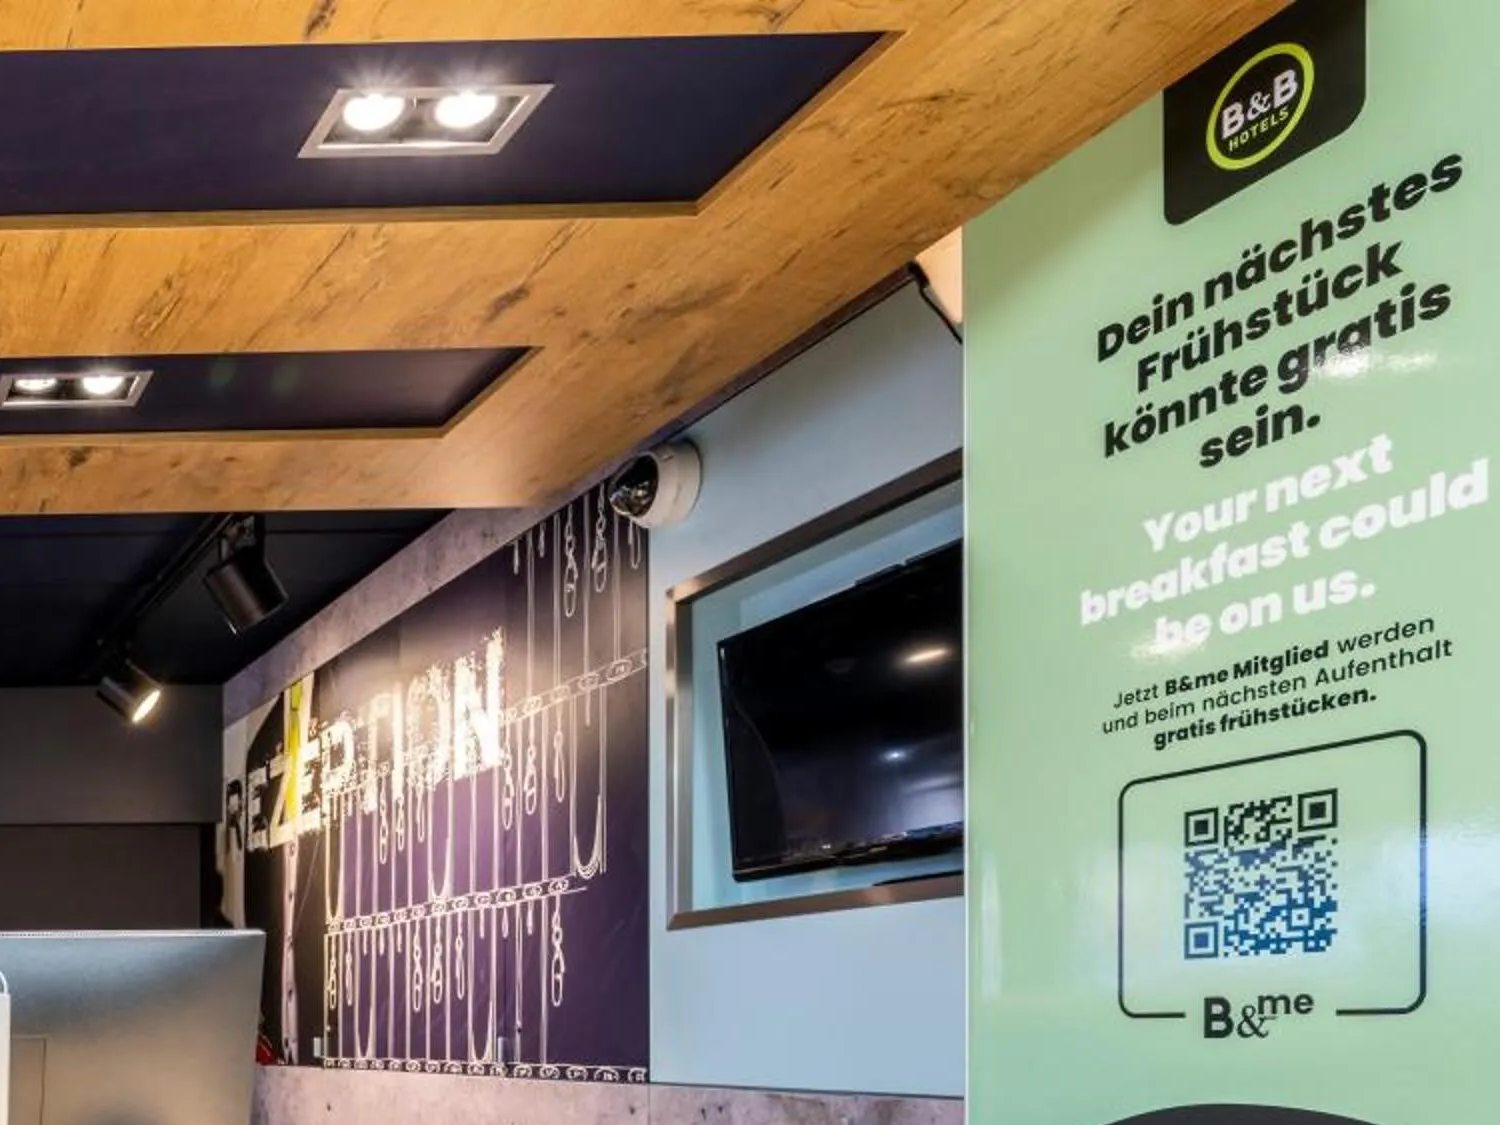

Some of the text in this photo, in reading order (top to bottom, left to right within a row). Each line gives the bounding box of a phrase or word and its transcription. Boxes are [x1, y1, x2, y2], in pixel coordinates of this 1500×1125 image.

[1221, 69, 1298, 140] B&B
[1228, 106, 1290, 152] HOTELS
[1098, 153, 1464, 362] Dein nächstes
[1138, 240, 1404, 393] Frühstück
[1104, 282, 1451, 458] könnte gratis
[1200, 404, 1321, 468] sein.
[1143, 433, 1393, 552] Your next
[1081, 458, 1490, 625] breakfast could
[1154, 569, 1376, 654] be on us.
[1103, 639, 1453, 735] und beim nächsten Aufenthalt
[1113, 616, 1435, 708] Jetzt B&me Mitglied werden
[1154, 687, 1377, 751] gratis frühstücken.
[1203, 993, 1315, 1039] B&me
